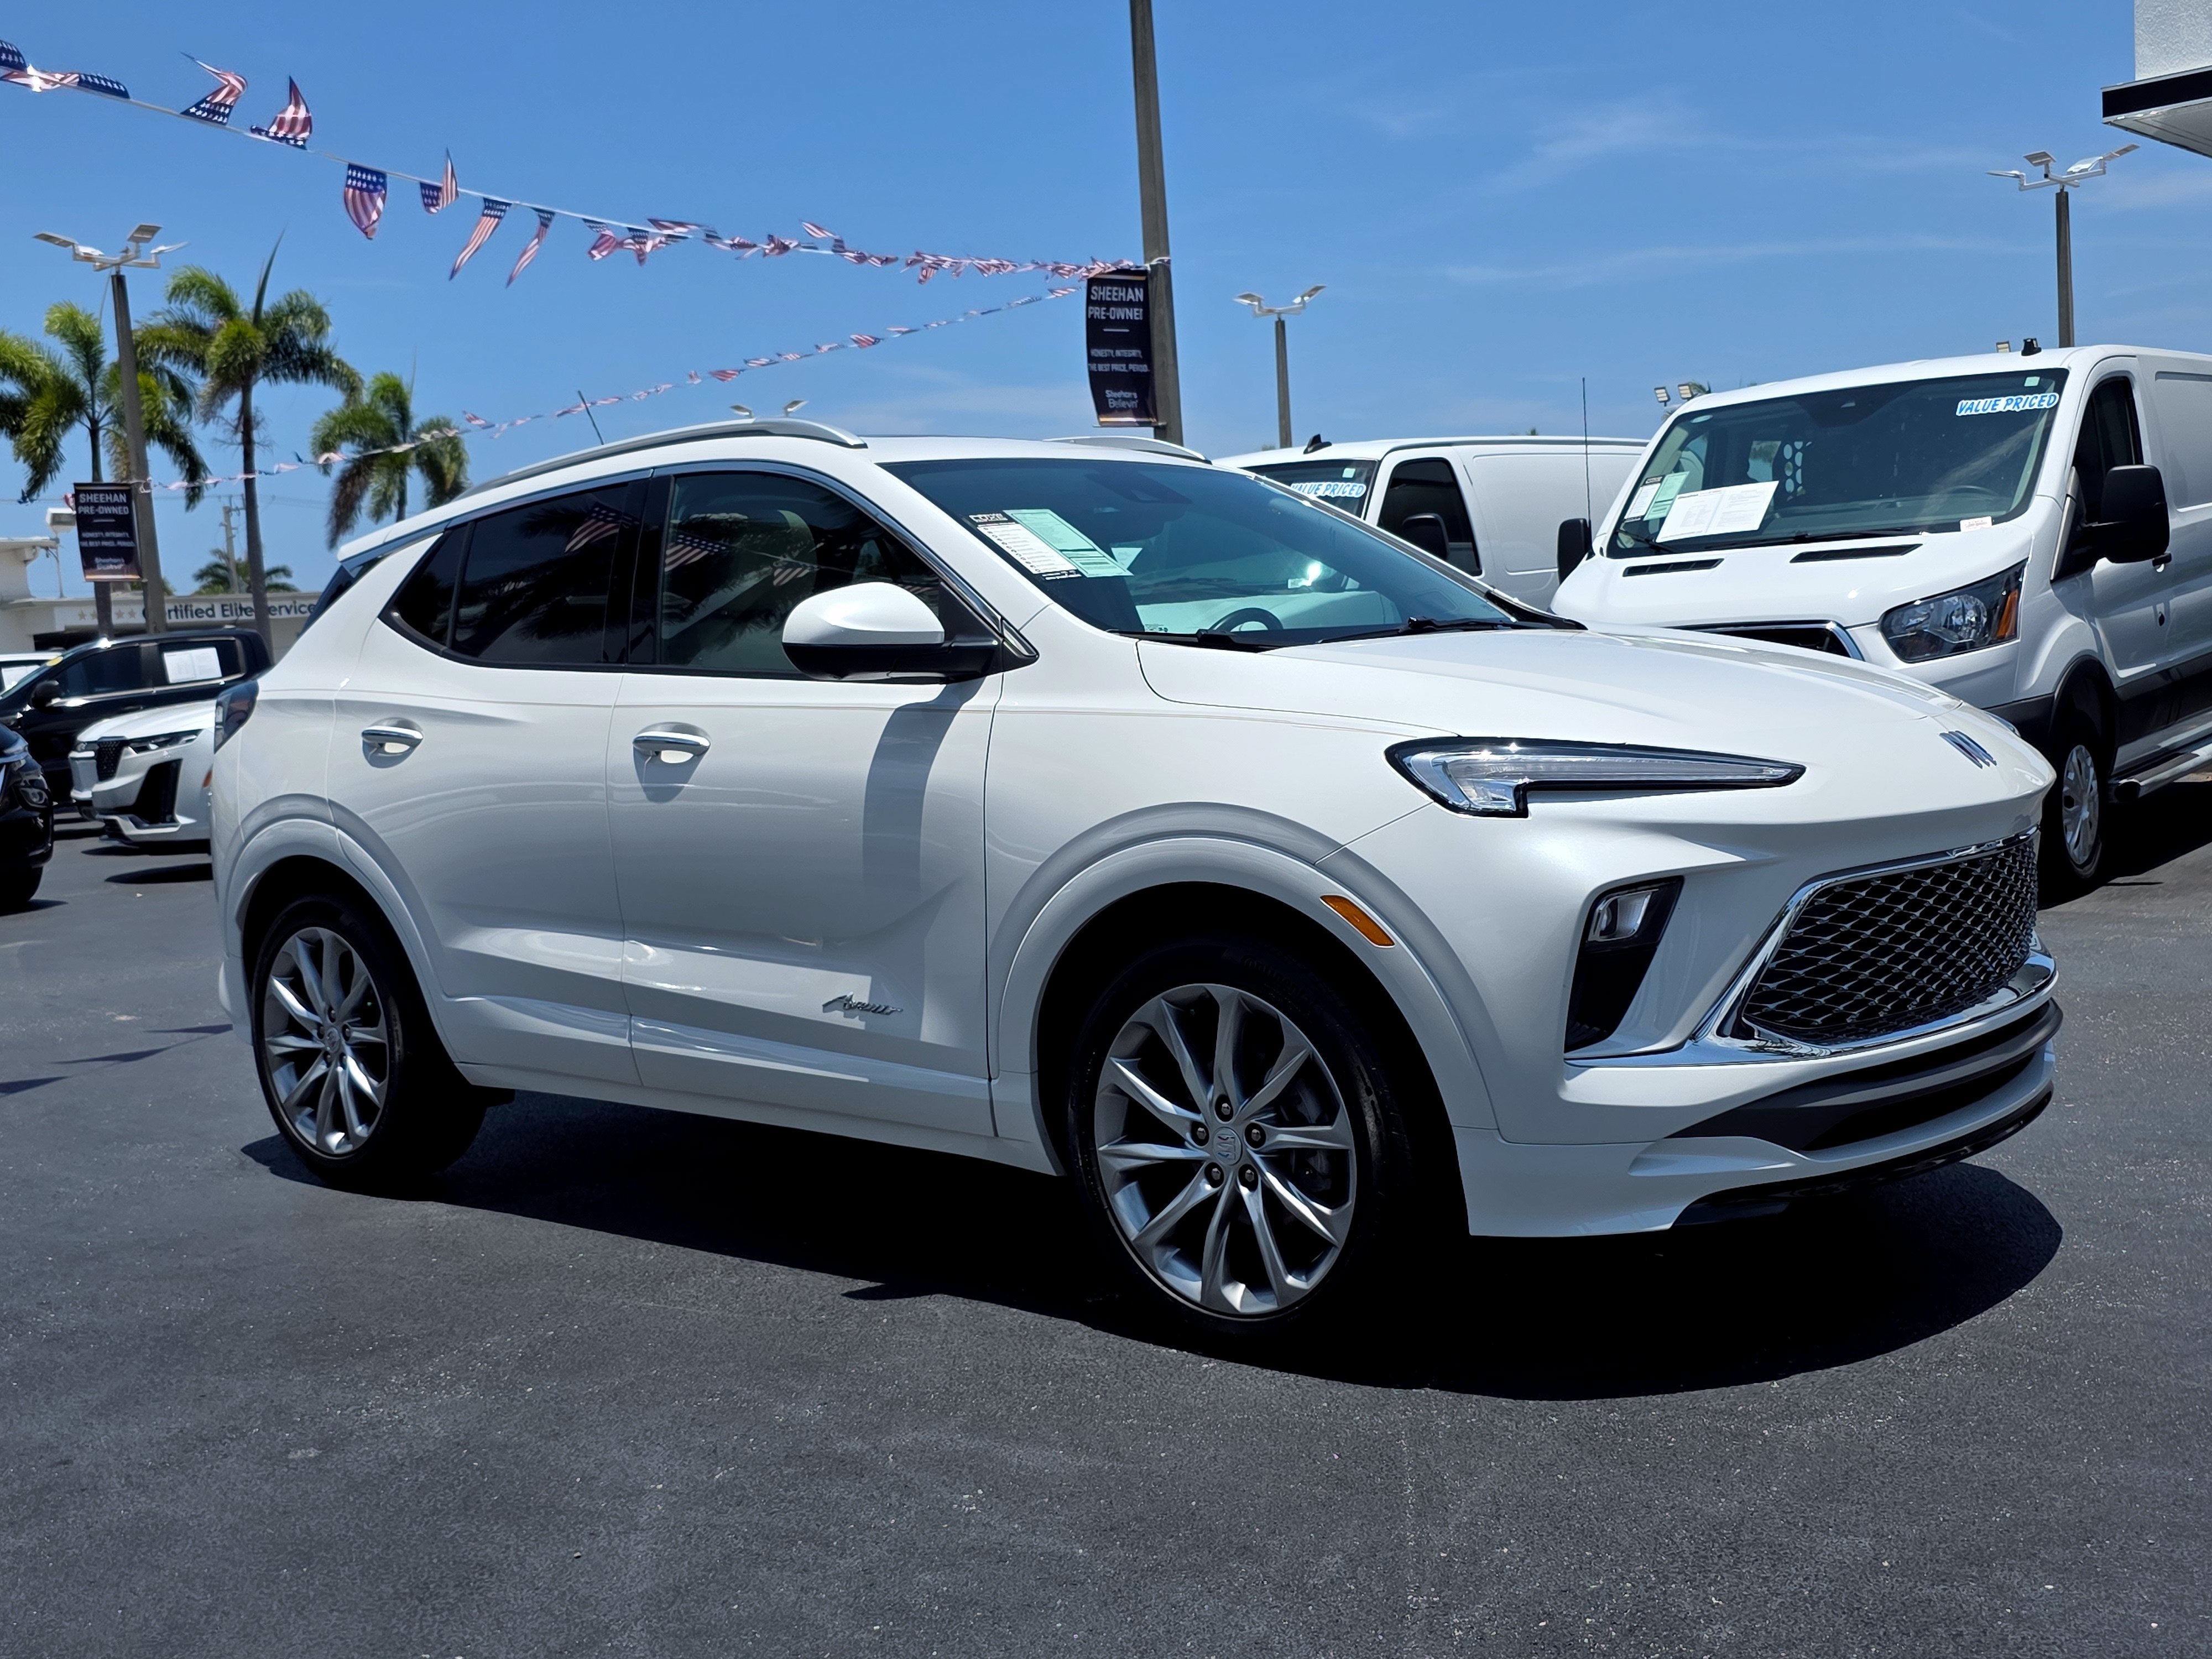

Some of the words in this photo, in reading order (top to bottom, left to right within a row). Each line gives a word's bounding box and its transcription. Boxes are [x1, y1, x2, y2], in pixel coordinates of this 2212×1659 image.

[1091, 286, 1144, 301] SHEEHAN
[1959, 399, 2001, 414] VALUE
[2003, 394, 2057, 410] PRICED
[1323, 484, 1364, 496] PRICED
[79, 493, 127, 503] SHEEHAN
[78, 505, 129, 515] PRE-OWNED
[142, 603, 216, 619] rtified
[221, 602, 254, 618] Elite
[268, 600, 316, 616] ervice
